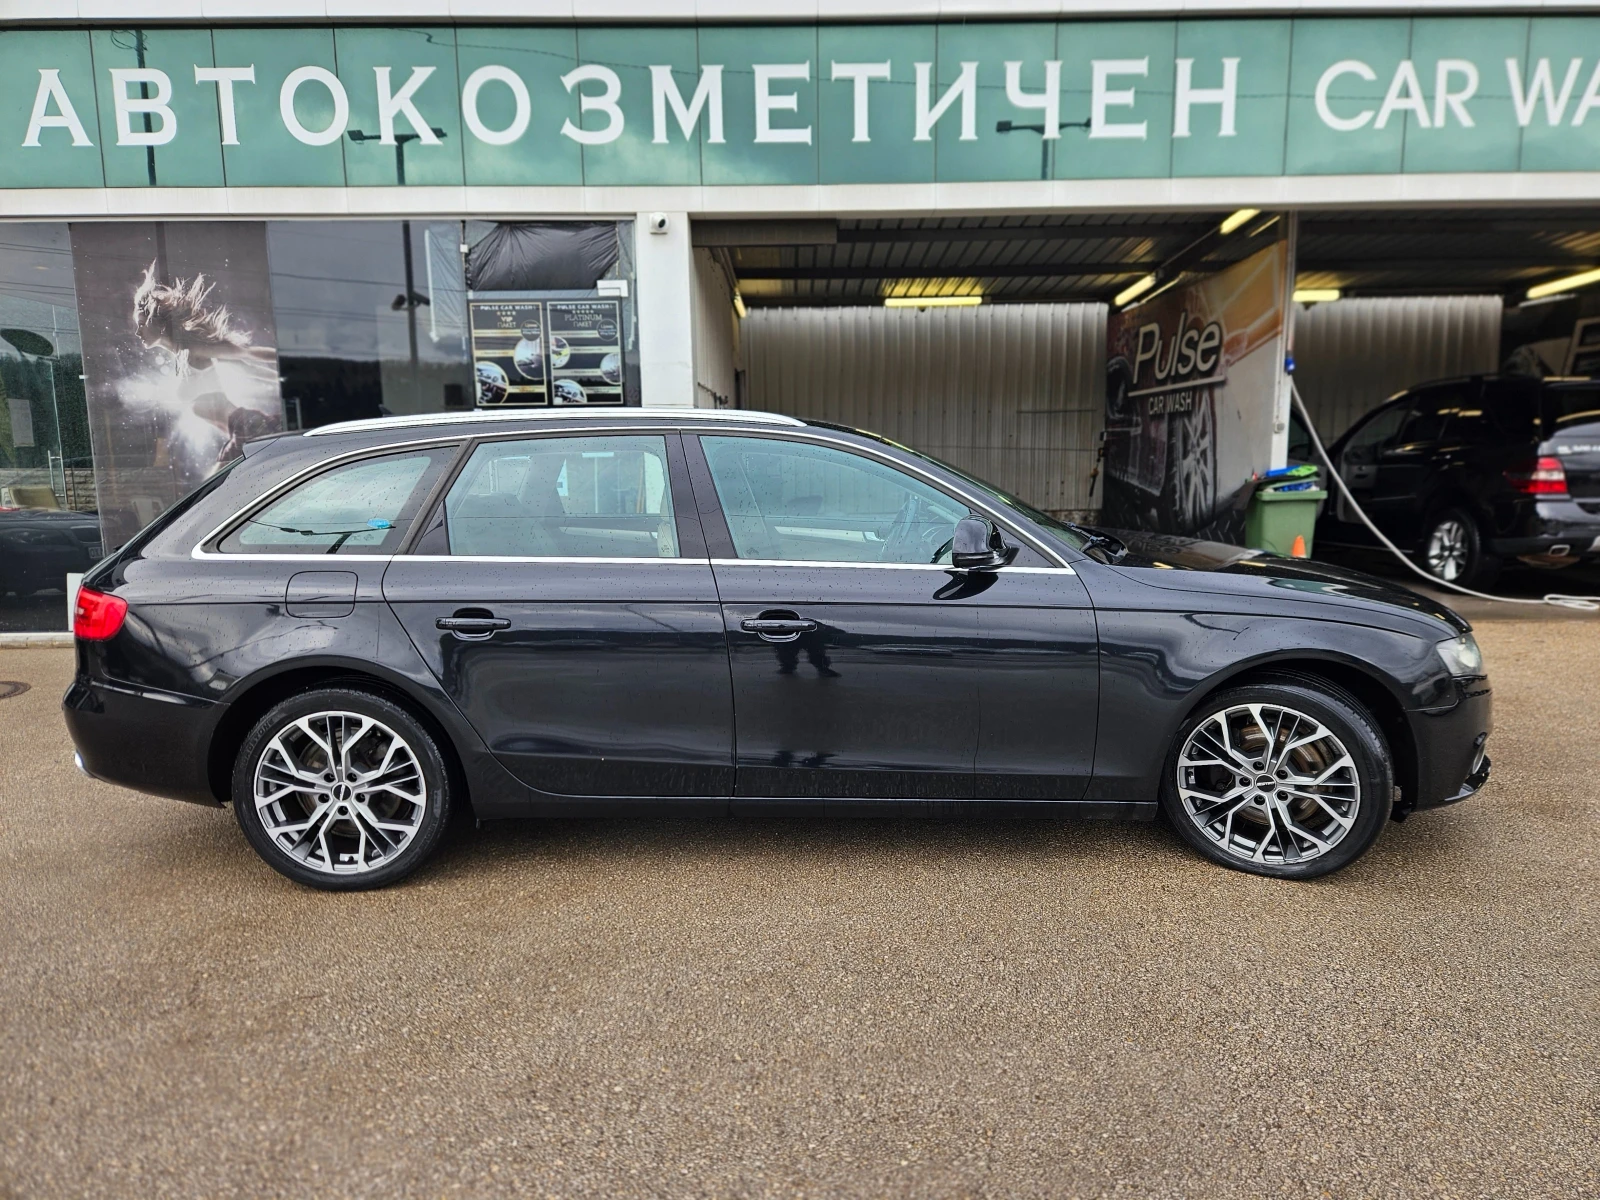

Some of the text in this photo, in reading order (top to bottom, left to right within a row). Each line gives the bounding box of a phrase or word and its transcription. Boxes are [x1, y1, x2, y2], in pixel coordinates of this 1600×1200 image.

[22, 57, 1241, 148] АВТОКОЗМЕТИЧЕН
[1314, 59, 1479, 131] CAR
[564, 313, 603, 321] PLATINUM
[1133, 312, 1220, 384] Pulse
[1149, 391, 1192, 415] CAR WASH
